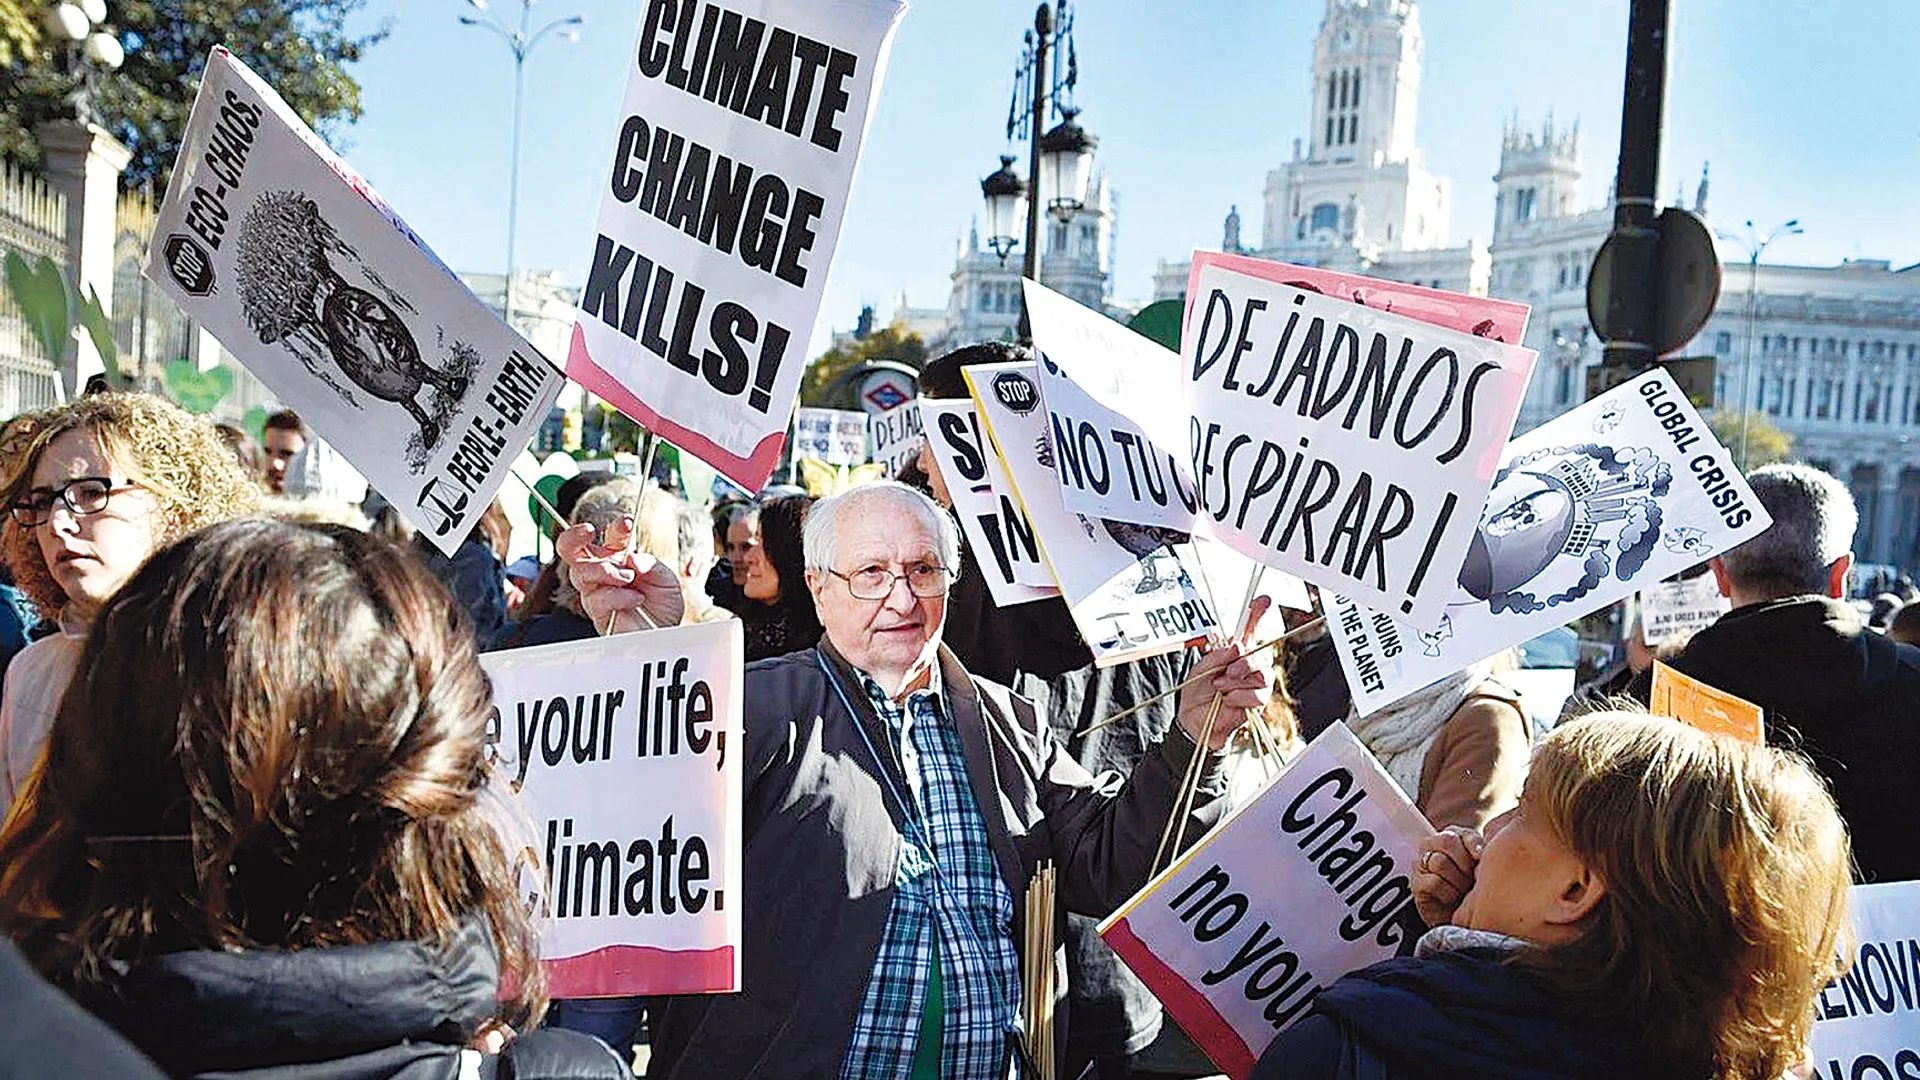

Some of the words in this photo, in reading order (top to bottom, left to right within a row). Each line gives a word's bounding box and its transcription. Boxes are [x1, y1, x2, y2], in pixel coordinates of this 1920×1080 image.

[638, 0, 857, 153] CLIMATE
[611, 115, 825, 288] CHANGE
[173, 242, 205, 288] STOP
[582, 233, 791, 414] KILLS!
[997, 379, 1031, 403] STOP
[1050, 411, 1111, 496] NO
[1110, 429, 1168, 507] TU
[1639, 380, 1700, 454] GLOBAL
[1689, 454, 1752, 529] CRISIS
[1339, 603, 1359, 636] THE
[1348, 633, 1385, 695] PLANET
[514, 688, 625, 795] your
[637, 656, 727, 772] life,
[1167, 863, 1250, 942] no
